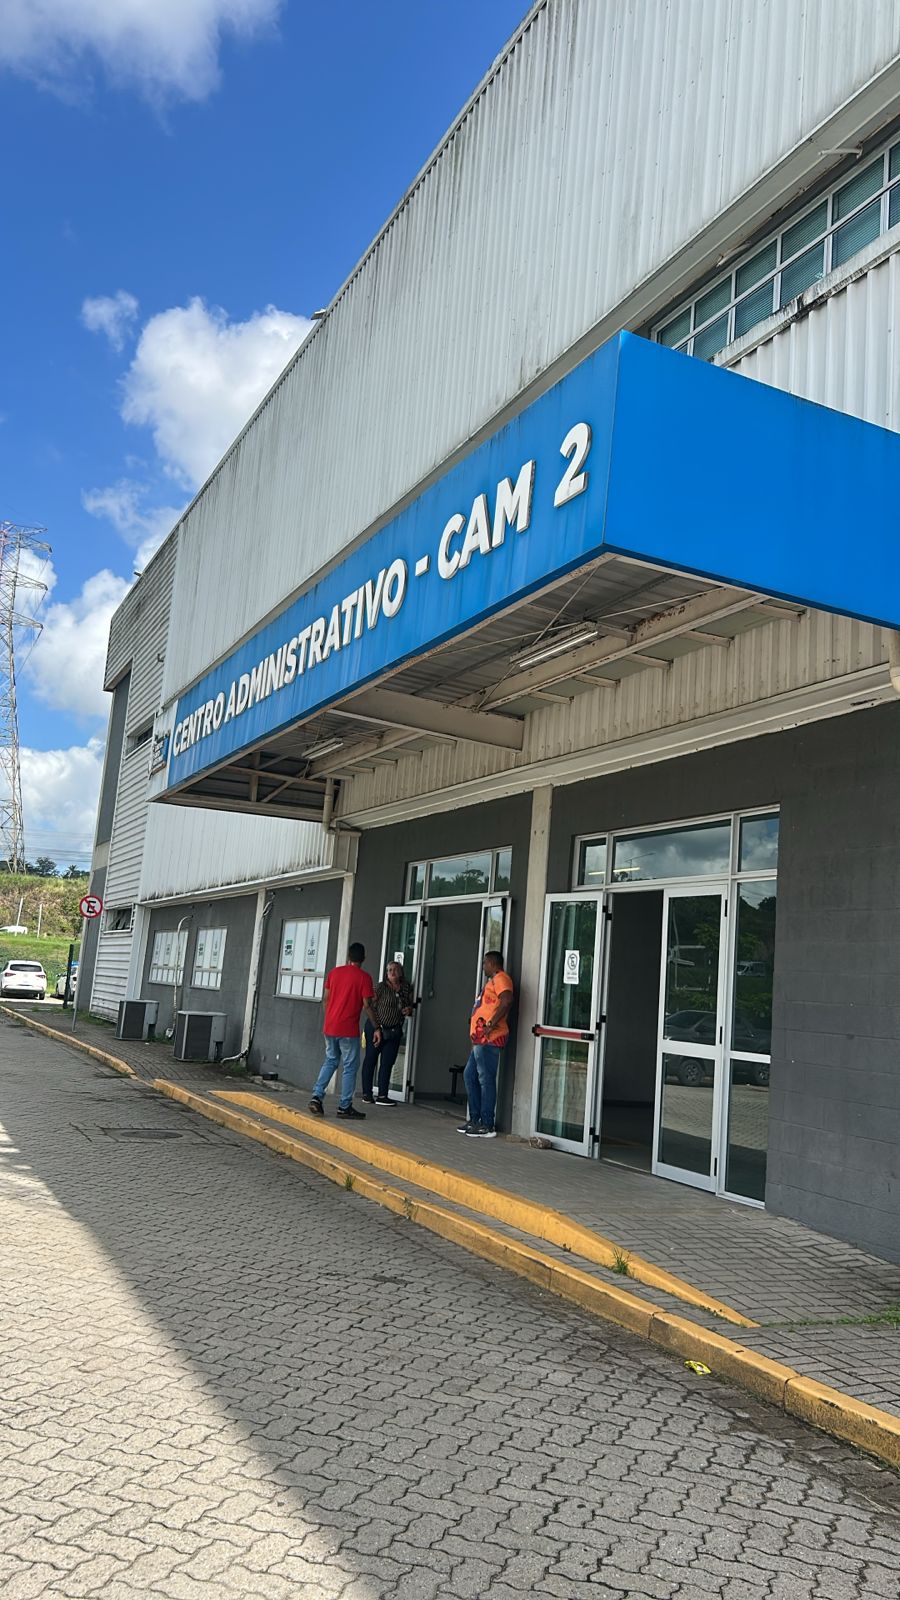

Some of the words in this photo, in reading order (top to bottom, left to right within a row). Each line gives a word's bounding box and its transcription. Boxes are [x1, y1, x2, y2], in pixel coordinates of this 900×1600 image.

[172, 691, 226, 756] CENTRO
[225, 558, 407, 718] ADMINISTRATIVO
[415, 554, 429, 576] -
[438, 459, 535, 579] CAM
[553, 422, 591, 507] 2
[87, 900, 96, 913] E
